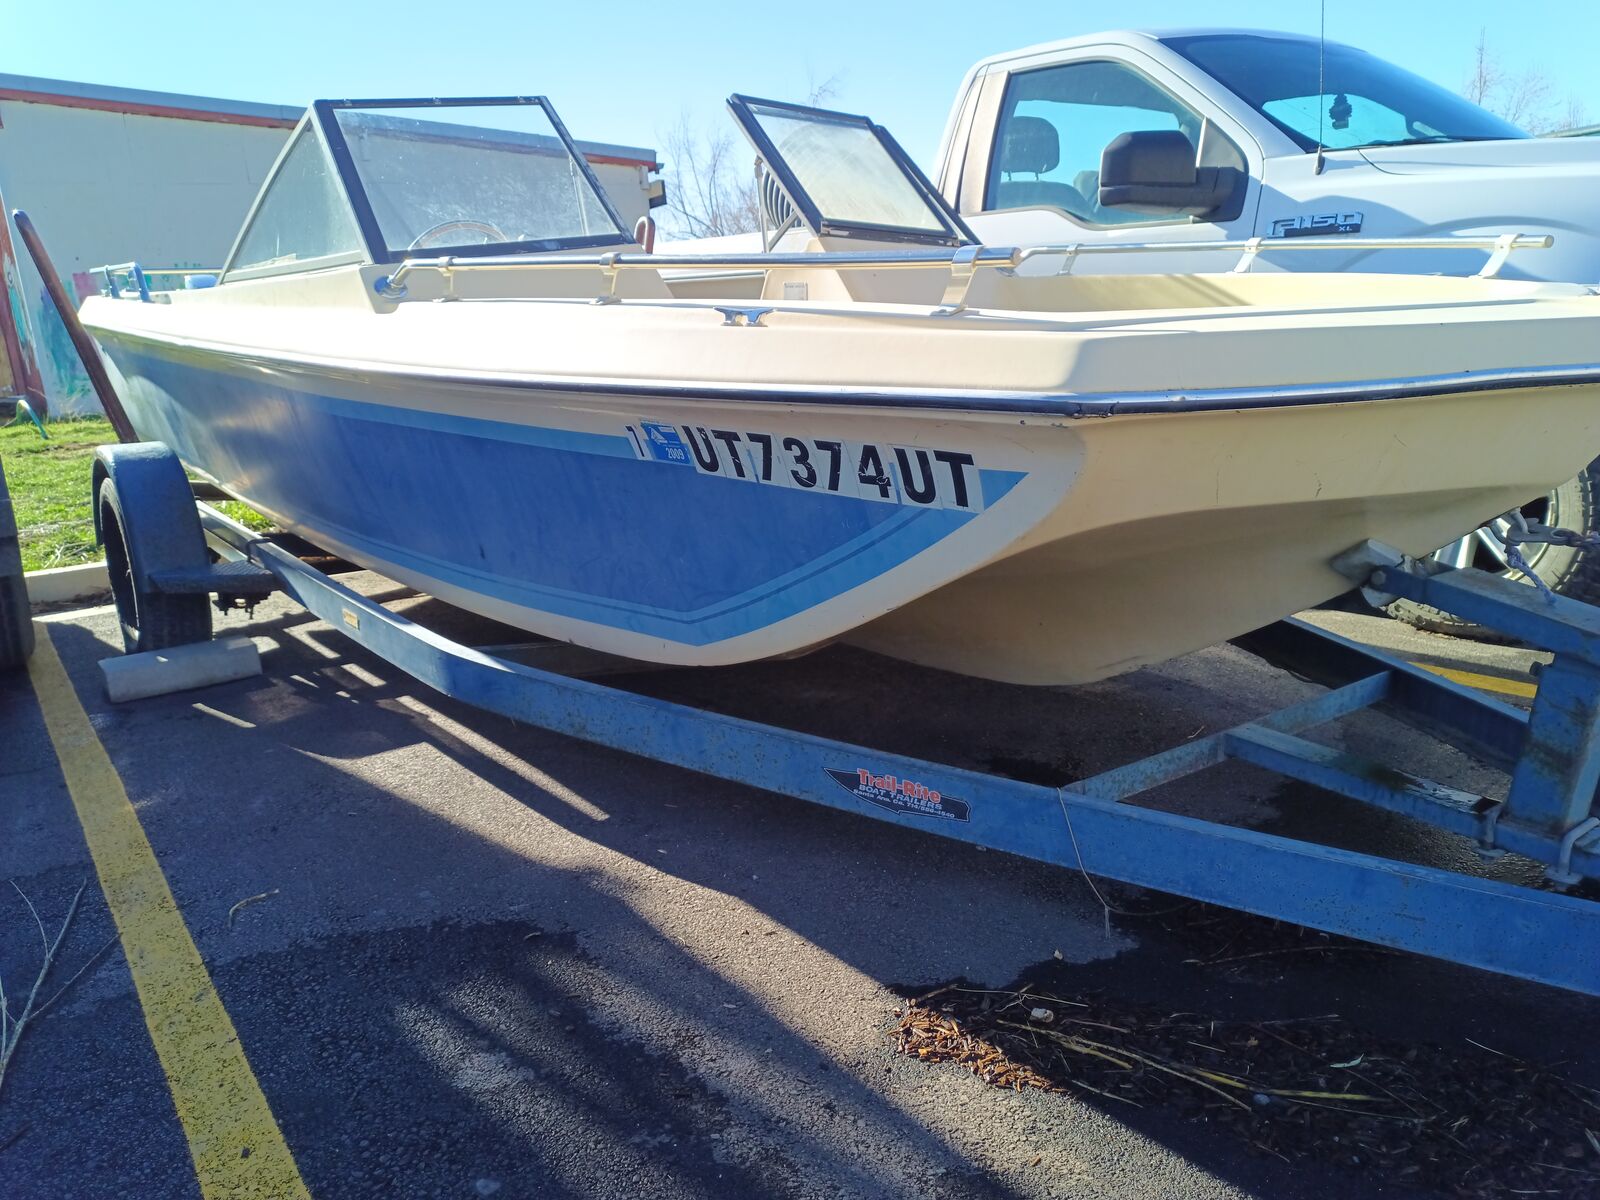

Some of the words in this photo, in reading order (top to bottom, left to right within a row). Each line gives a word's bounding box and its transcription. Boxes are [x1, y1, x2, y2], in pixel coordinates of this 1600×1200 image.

[666, 447, 685, 460] 2009
[681, 425, 975, 508] UT7374UT
[857, 768, 941, 803] Trail-Rite
[859, 784, 886, 796] BOAT
[889, 792, 943, 810] TRAILERS
